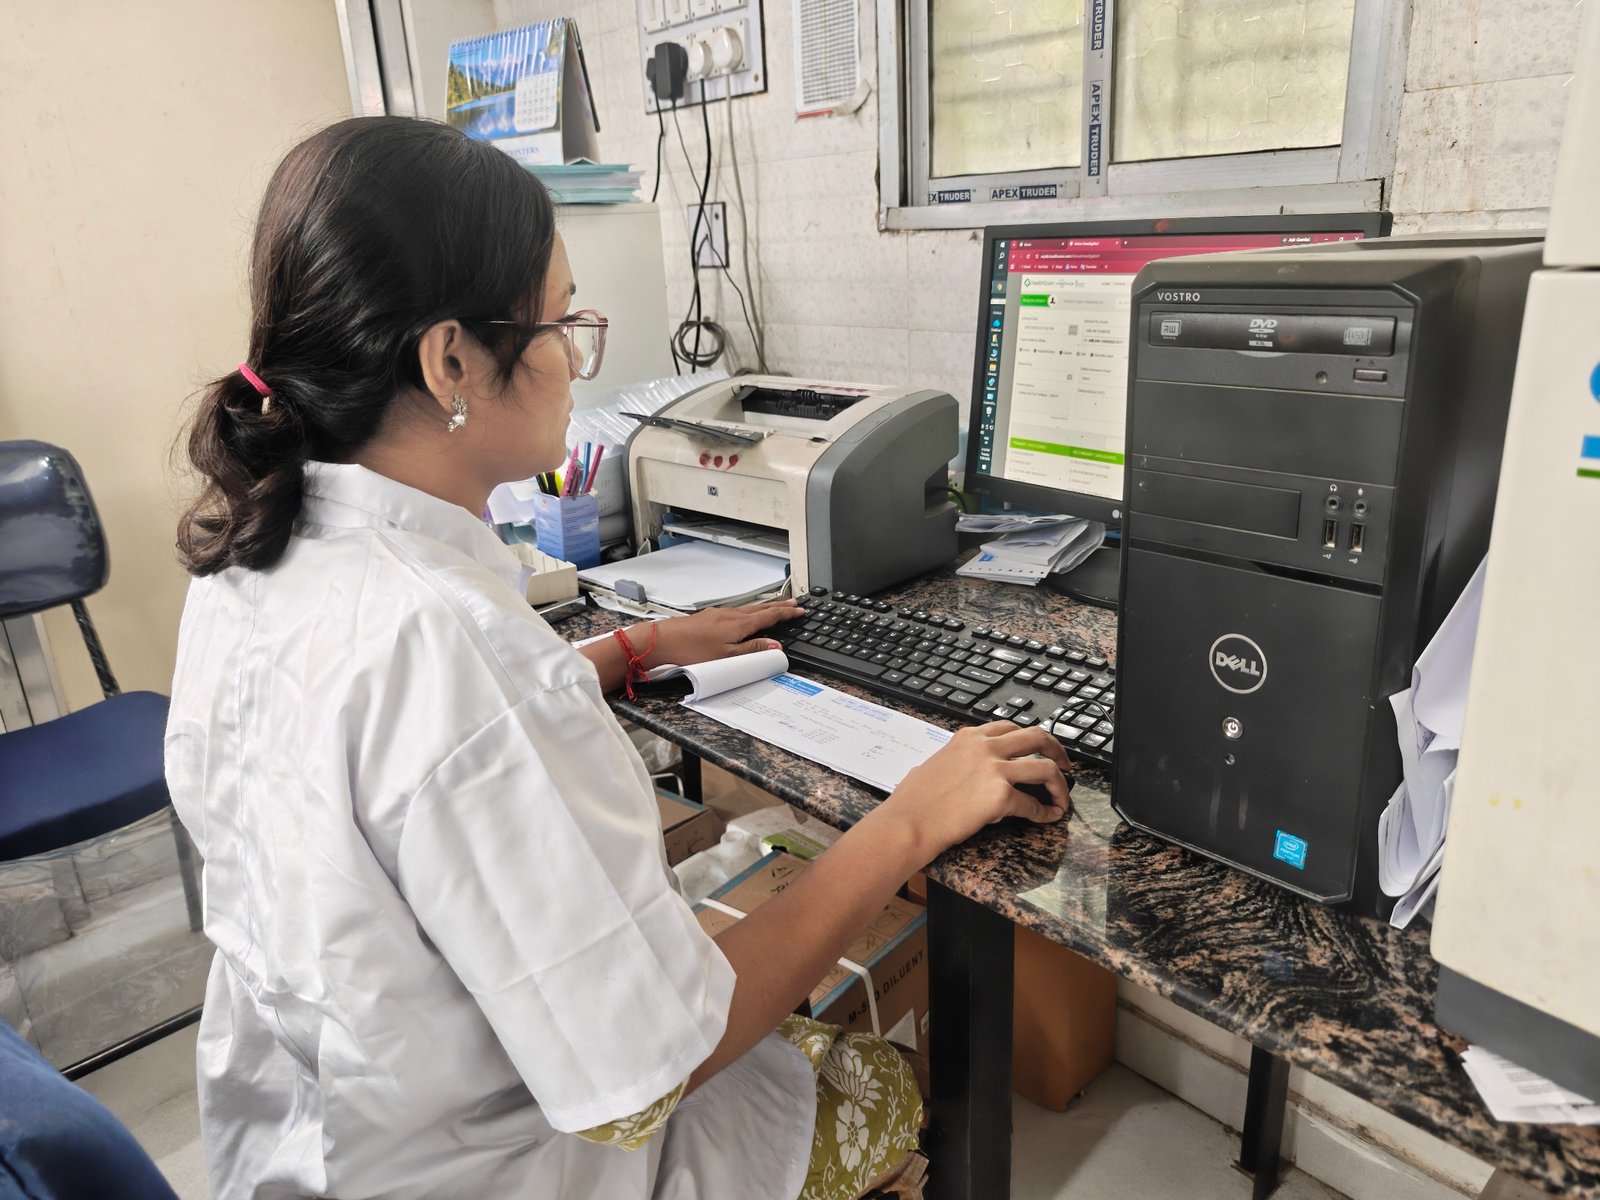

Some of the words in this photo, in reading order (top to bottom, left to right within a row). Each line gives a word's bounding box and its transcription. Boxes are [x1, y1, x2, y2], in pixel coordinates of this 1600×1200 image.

[1093, 0, 1103, 50] TRUDER
[1091, 84, 1101, 123] APEX
[1090, 127, 1099, 176] TRUDER
[940, 191, 970, 202] TRUDER
[991, 188, 1019, 200] APEX
[1020, 186, 1056, 197] TRUDER
[1157, 292, 1200, 302] VOSTRO
[1249, 319, 1277, 328] DVD
[1216, 651, 1260, 677] DELL
[883, 949, 924, 994] DILUENT
